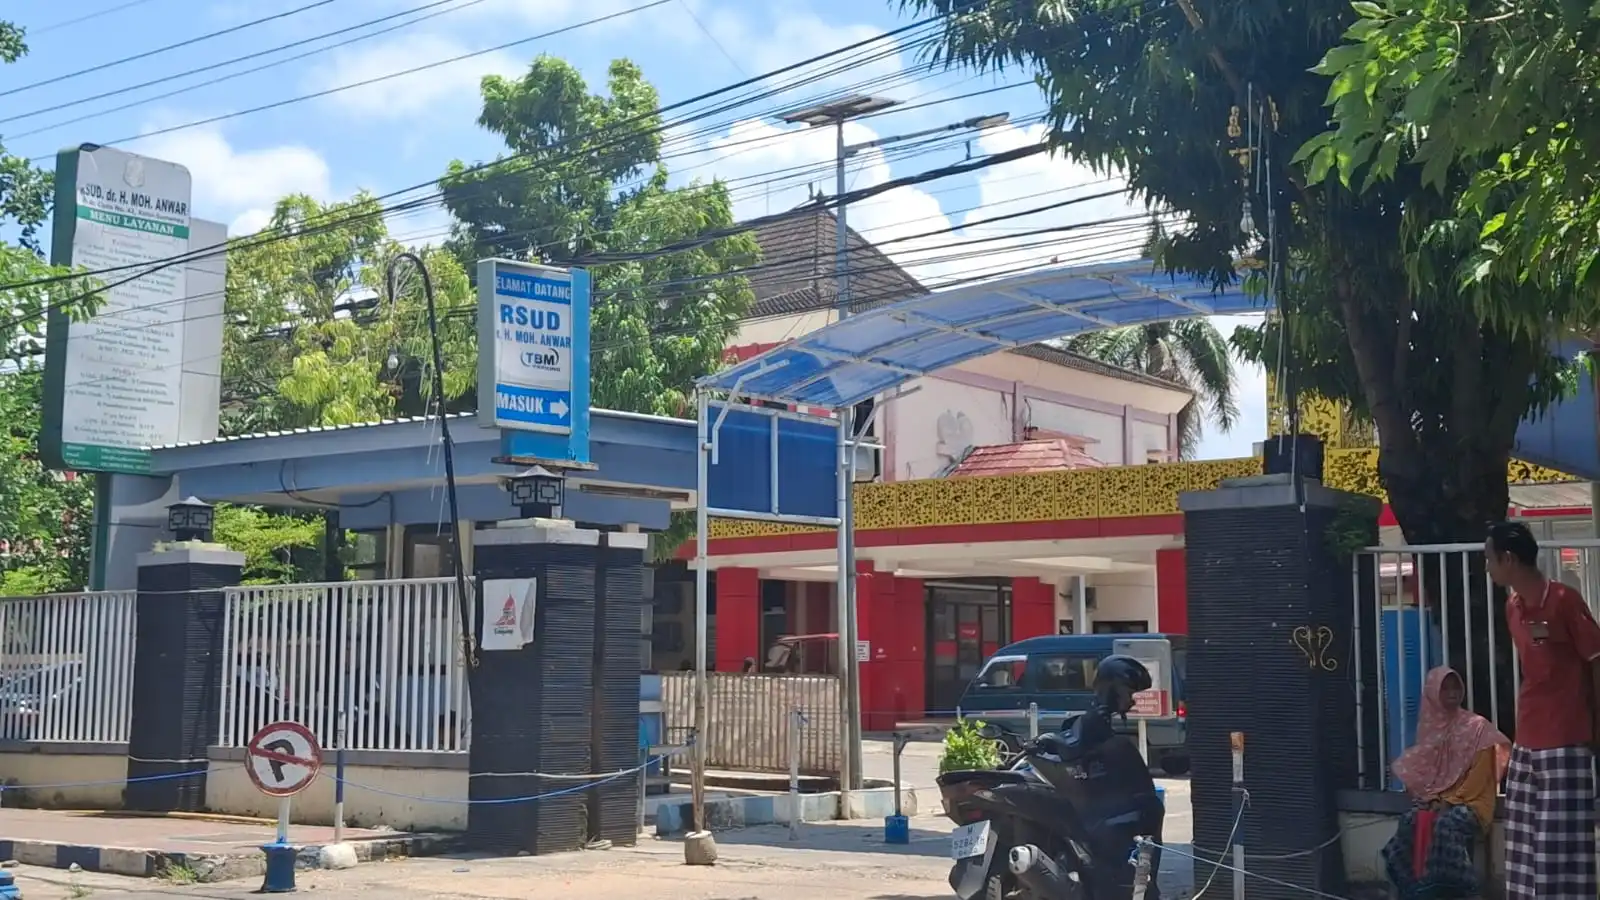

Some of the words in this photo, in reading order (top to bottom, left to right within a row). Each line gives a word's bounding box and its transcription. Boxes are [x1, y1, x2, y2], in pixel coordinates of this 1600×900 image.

[106, 188, 117, 202] dr.
[119, 190, 128, 204] H.
[131, 192, 153, 209] MOH.
[155, 198, 187, 216] ANWAR
[89, 209, 119, 225] MENU
[123, 215, 174, 234] LAYANAN
[500, 303, 561, 331] RSUD
[515, 329, 538, 345] MOH.
[540, 333, 571, 349] ANWAR
[526, 352, 555, 366] TBM
[496, 391, 544, 414] MASUK
